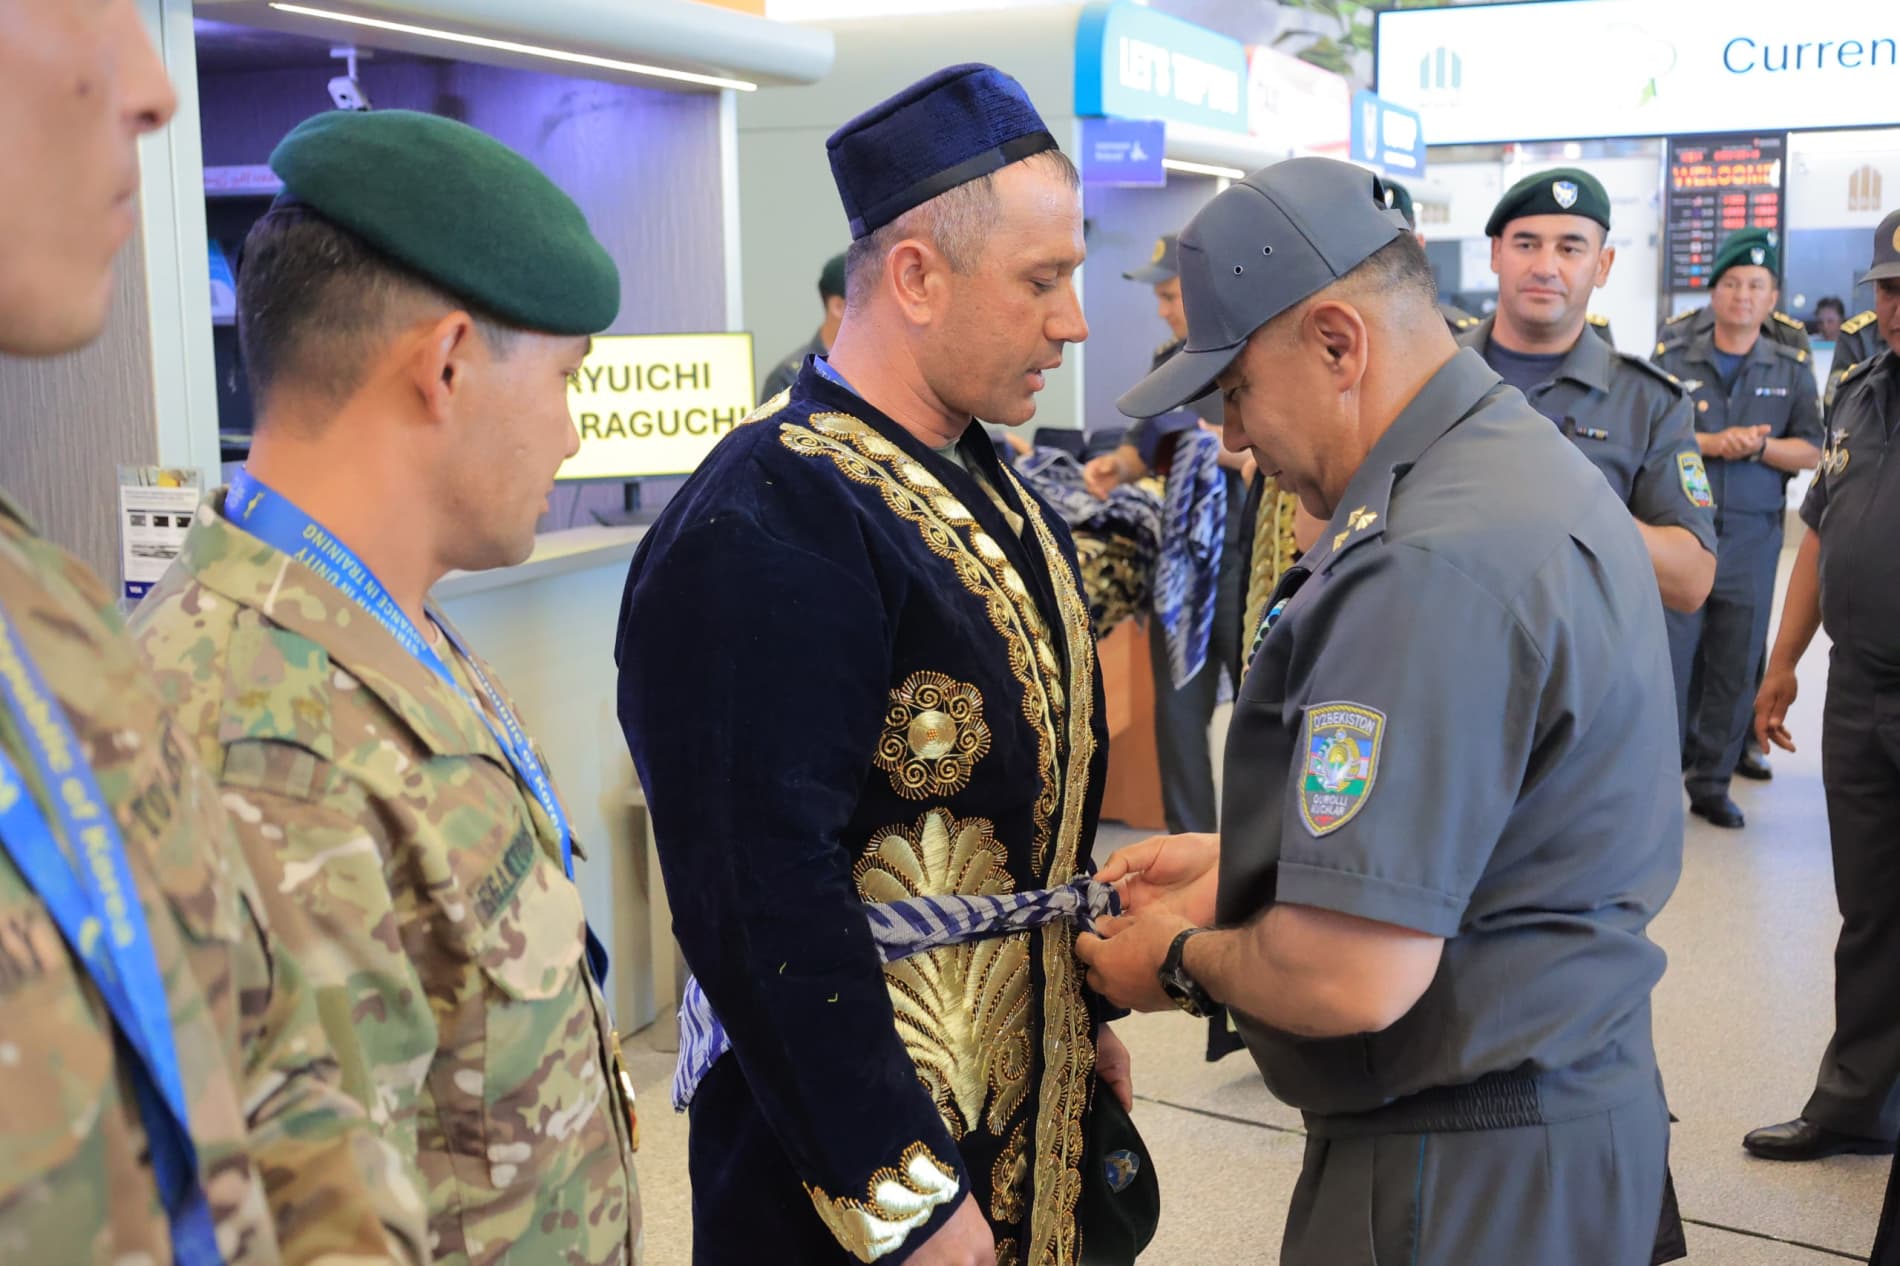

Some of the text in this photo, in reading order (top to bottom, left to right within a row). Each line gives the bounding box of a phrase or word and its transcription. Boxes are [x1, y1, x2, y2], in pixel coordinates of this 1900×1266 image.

[1723, 37, 1896, 74] Curren
[294, 547, 340, 587] UNITY
[302, 523, 367, 586] TRAINING
[363, 579, 380, 600] IN
